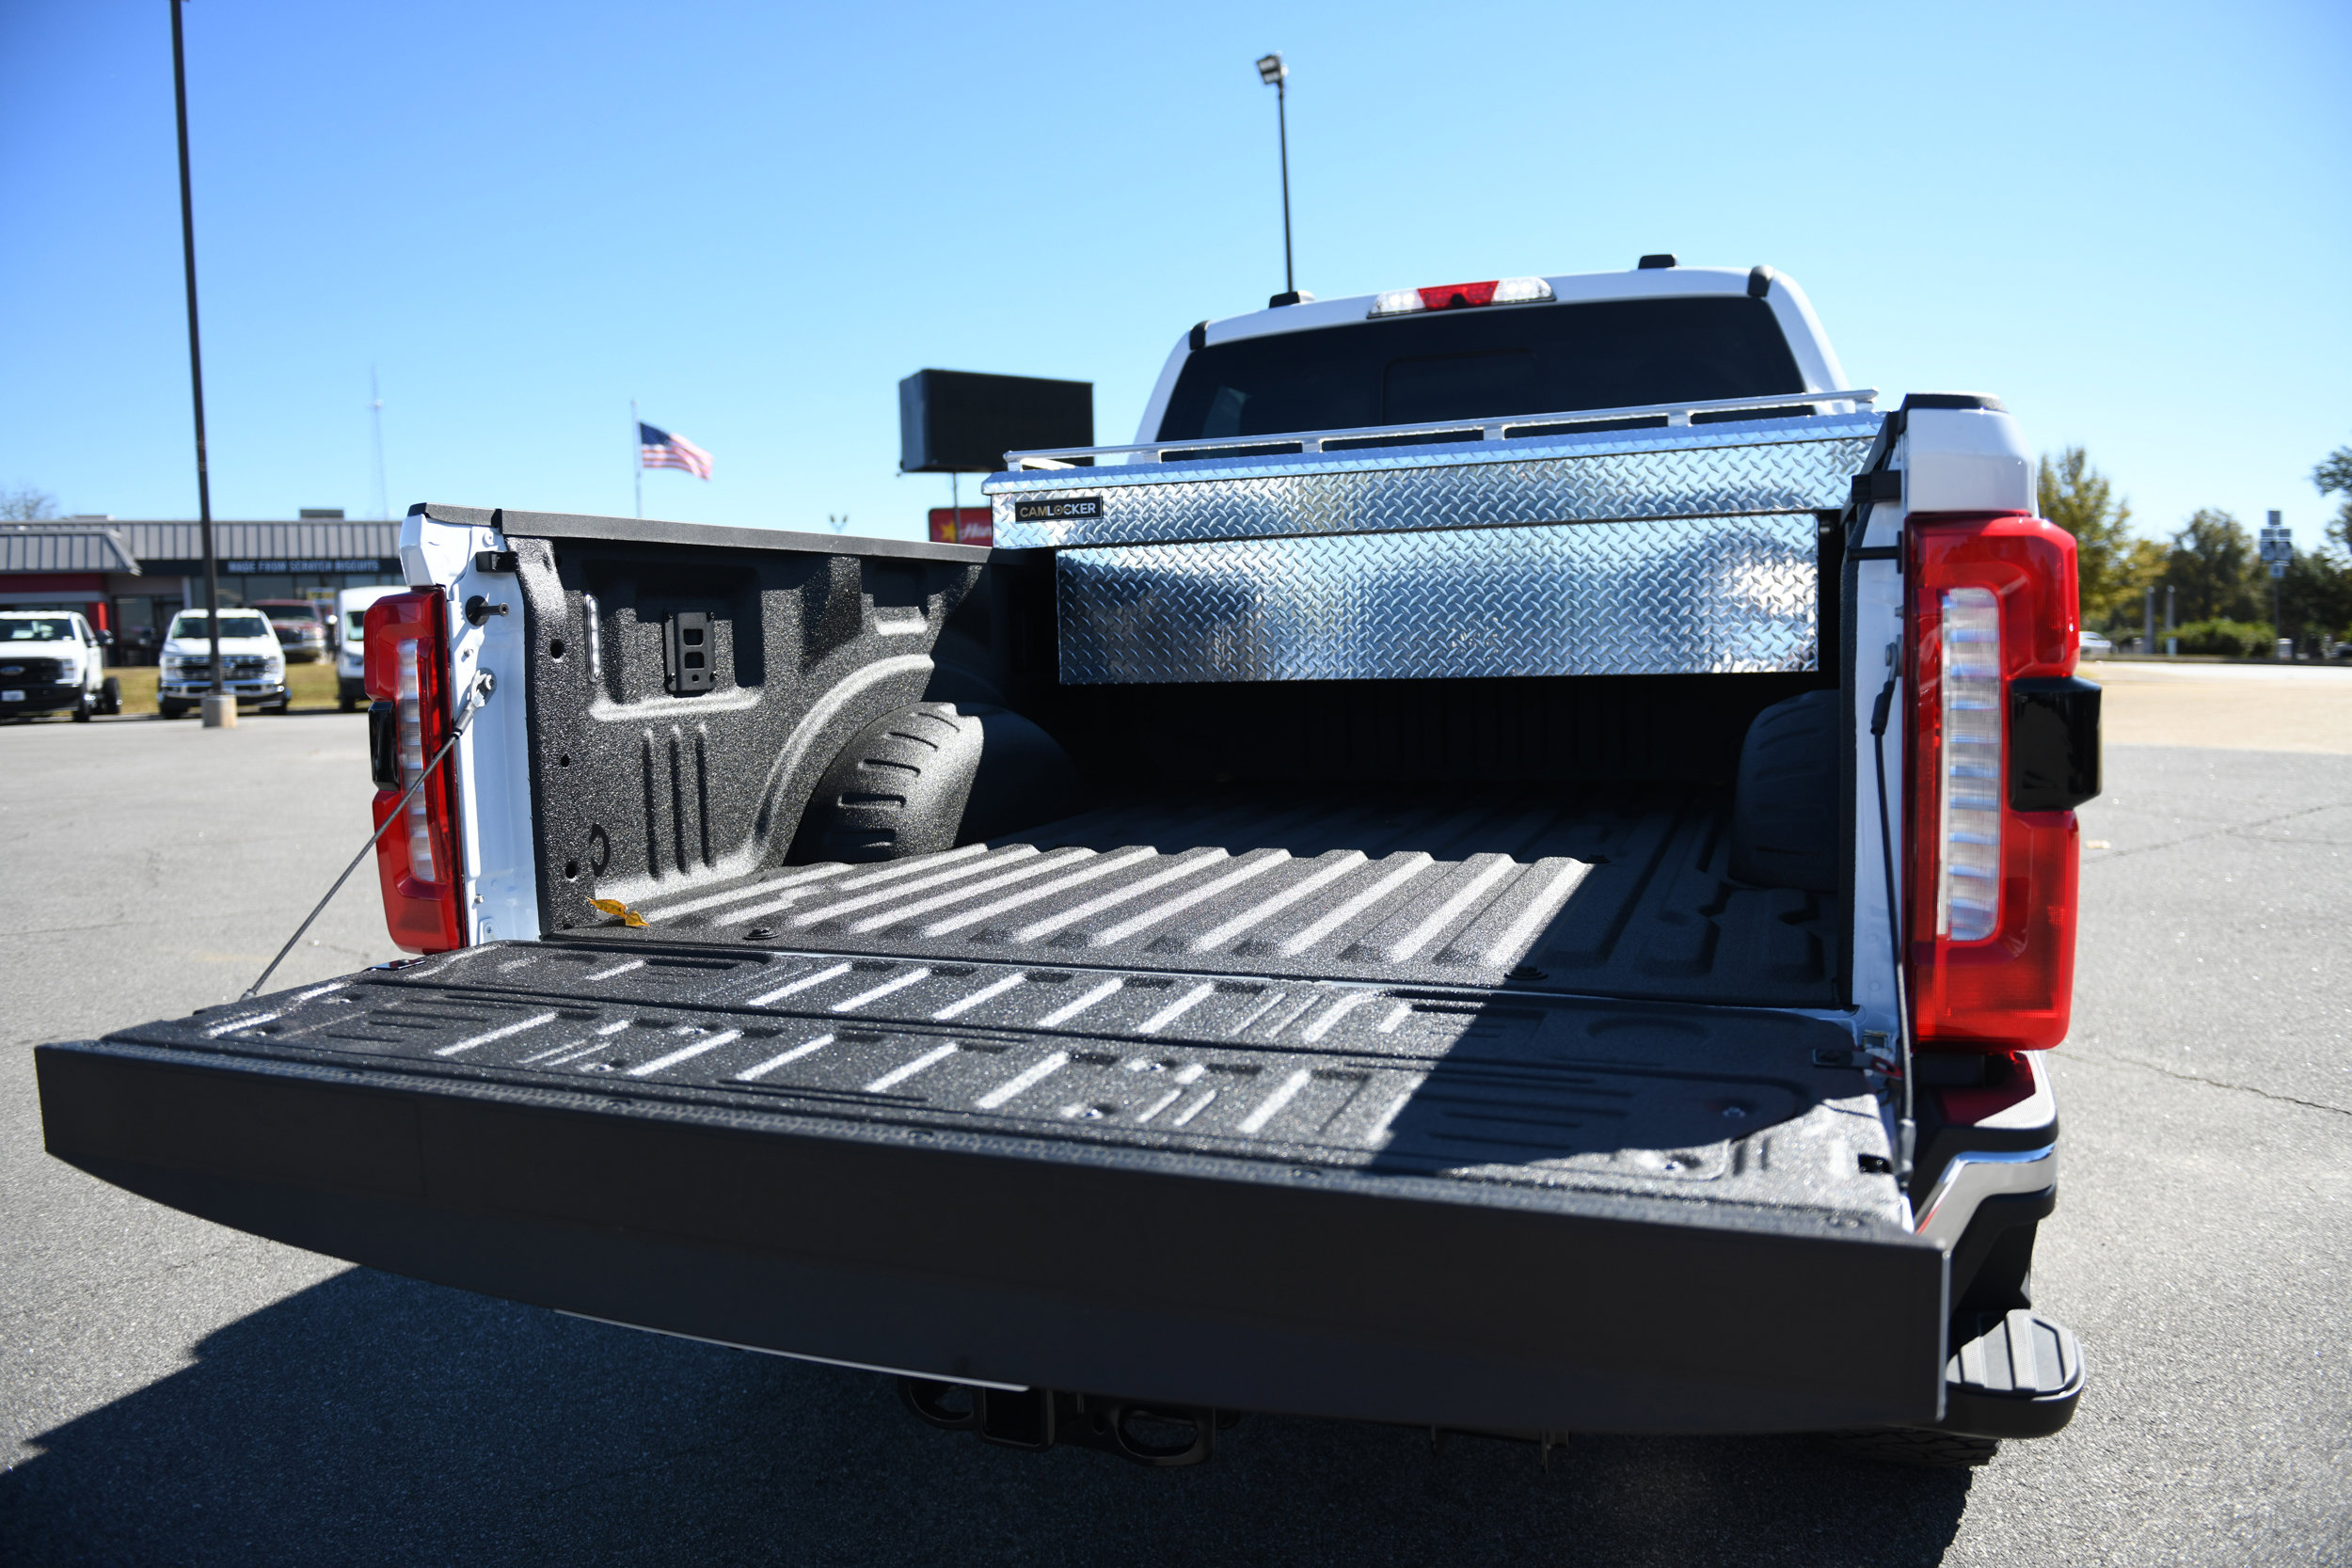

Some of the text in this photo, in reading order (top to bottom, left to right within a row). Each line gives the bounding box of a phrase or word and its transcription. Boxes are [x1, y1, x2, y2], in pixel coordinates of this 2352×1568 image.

[1019, 502, 1096, 517] CAMLOCKER
[229, 560, 379, 573] MADE FROM SCRATCH BISCUITS
